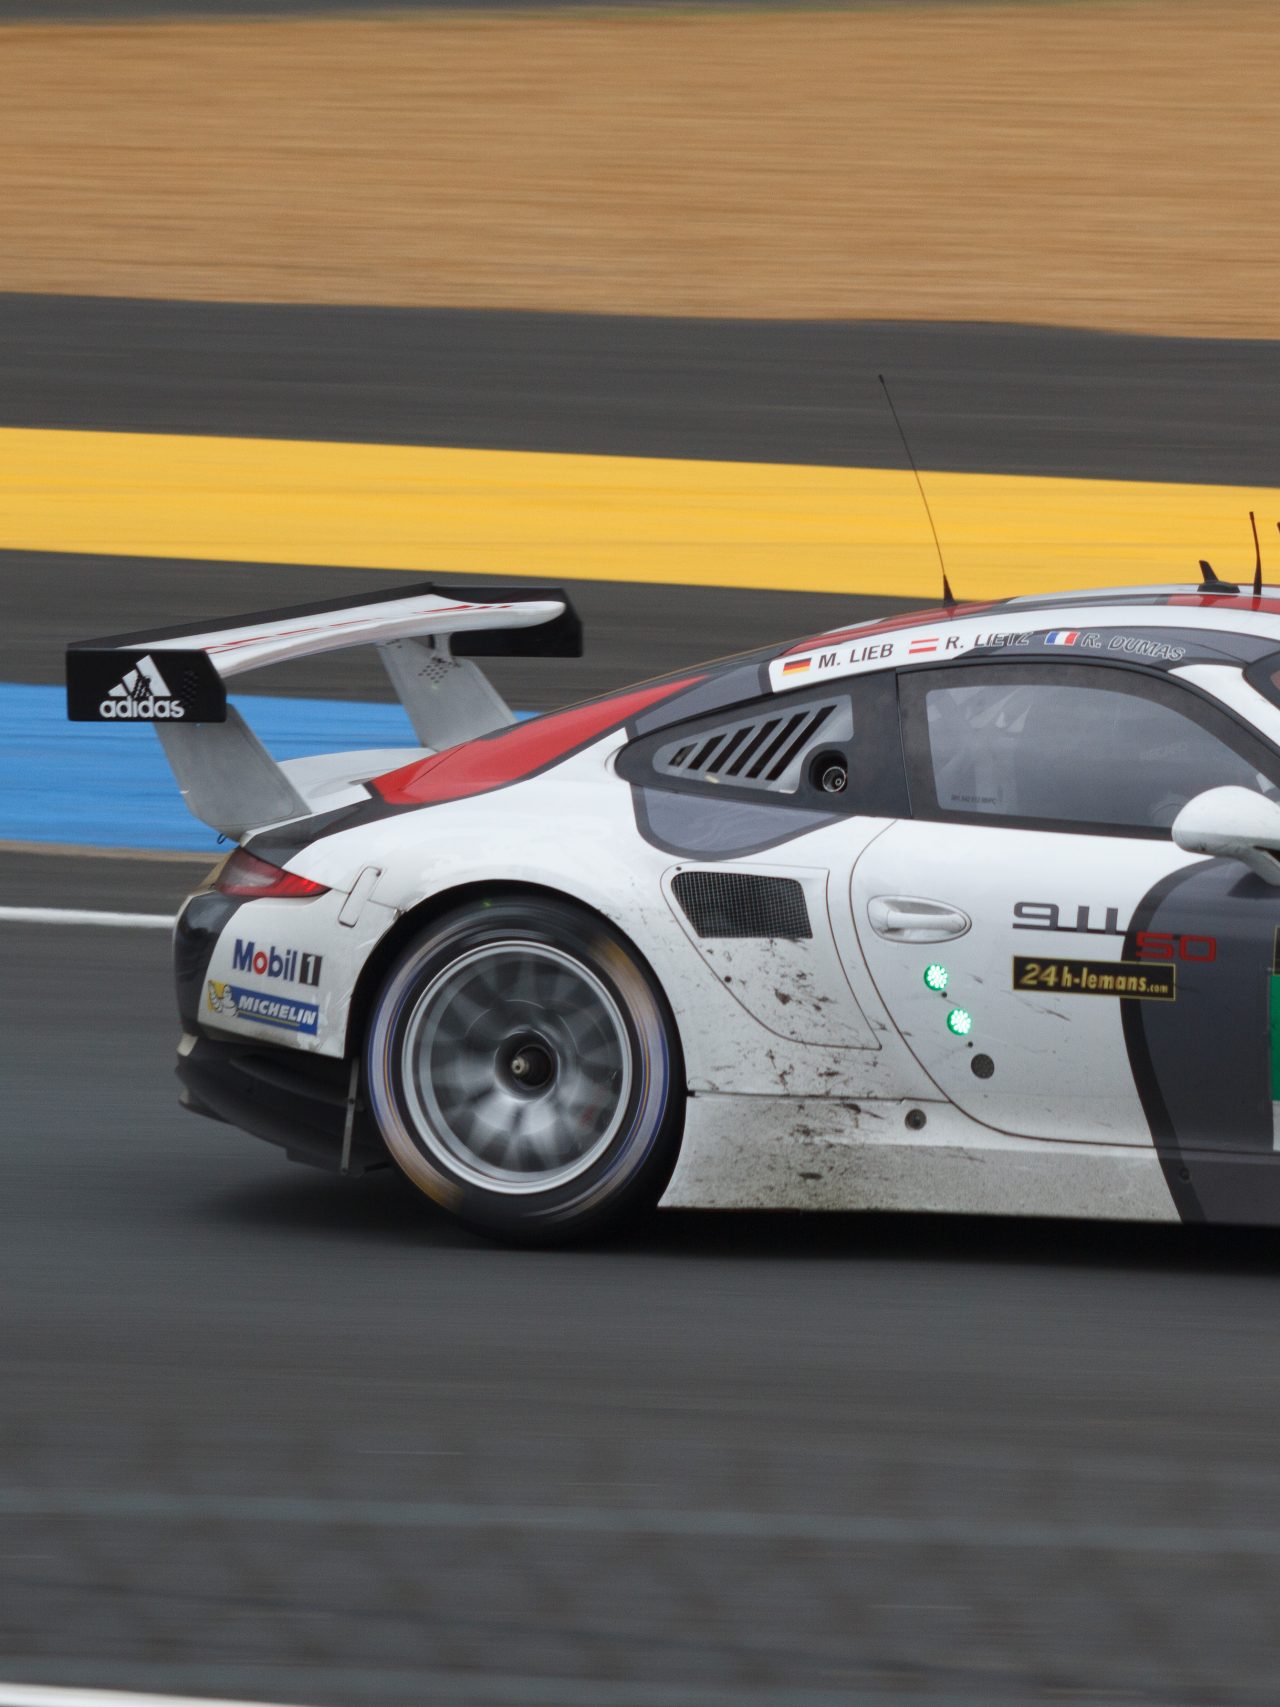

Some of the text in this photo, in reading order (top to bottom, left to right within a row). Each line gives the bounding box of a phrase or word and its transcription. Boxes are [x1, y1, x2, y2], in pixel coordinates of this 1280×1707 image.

[817, 643, 893, 668] M. LIEB
[945, 635, 964, 650] R.
[1081, 633, 1186, 662] R. DUMAS
[100, 696, 185, 719] adidas
[232, 939, 298, 982] Mobil
[1136, 931, 1217, 963] 50
[239, 995, 316, 1026] MICHELIN
